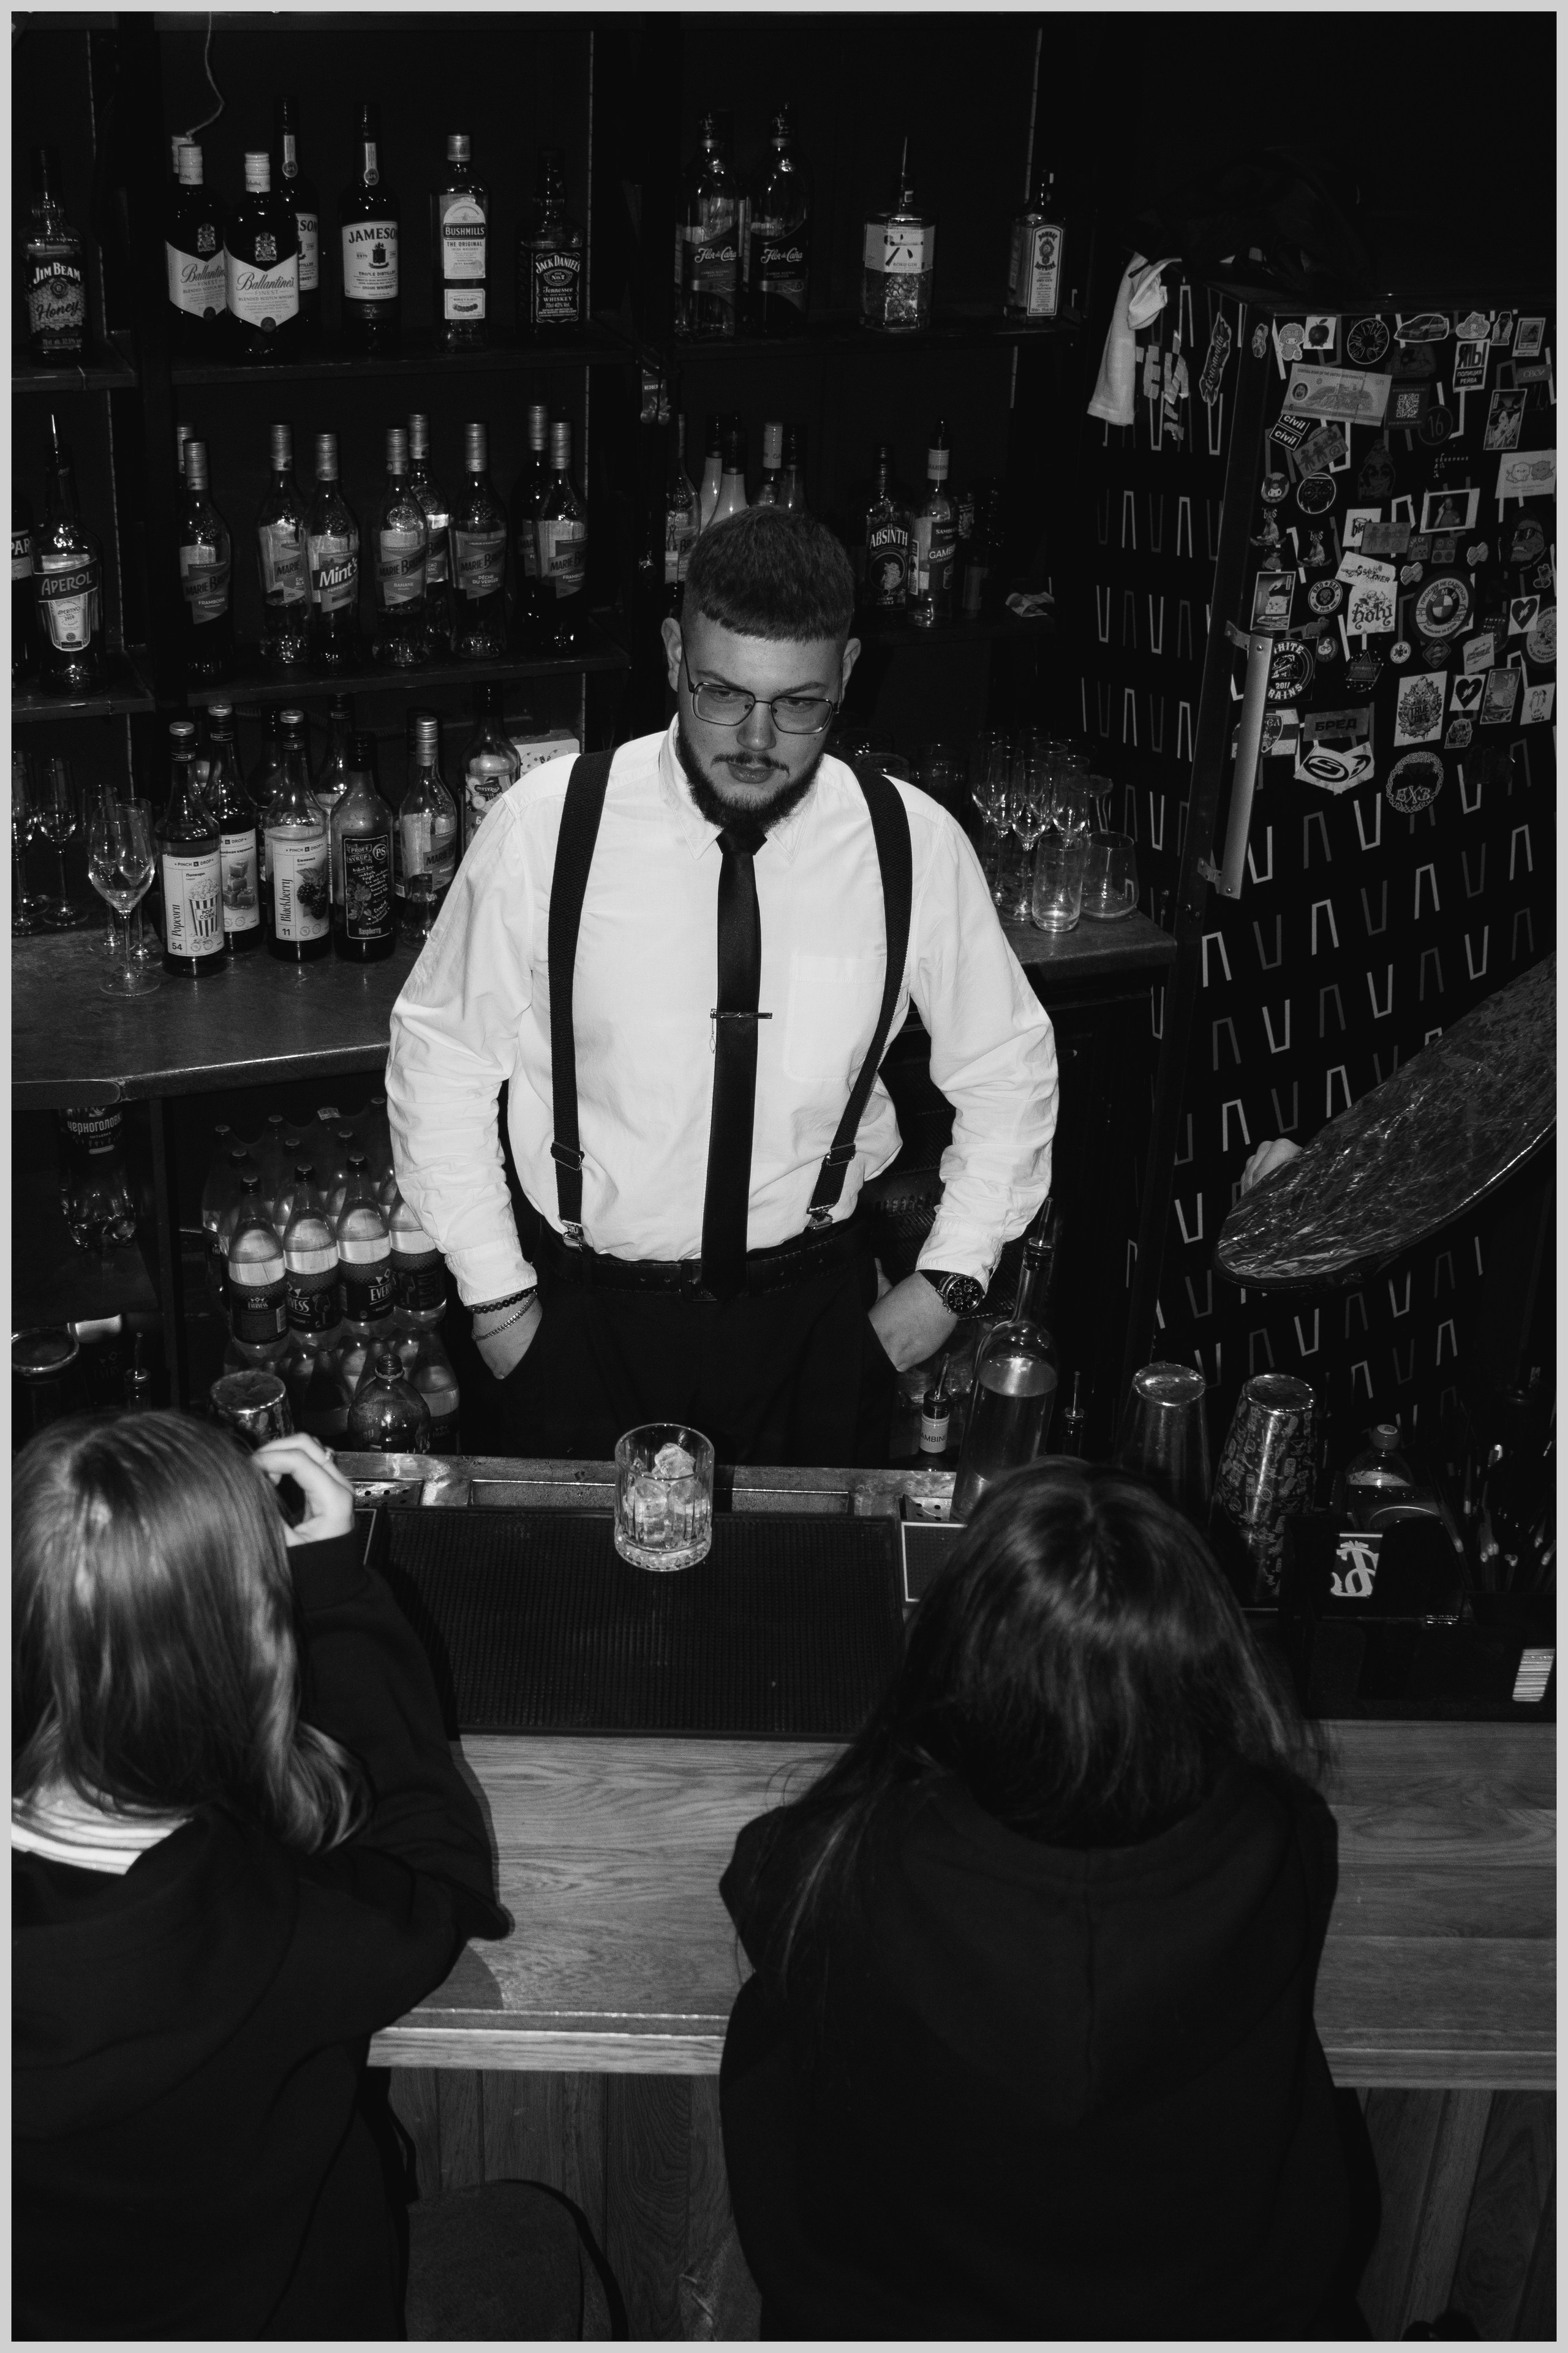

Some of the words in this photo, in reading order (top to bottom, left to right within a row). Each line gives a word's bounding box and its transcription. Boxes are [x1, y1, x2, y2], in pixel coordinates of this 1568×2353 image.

[445, 226, 485, 236] BUSHMILLS
[535, 258, 554, 274] JACK
[554, 255, 581, 273] DANIEL'S
[695, 247, 715, 263] Flor
[761, 248, 781, 264] Flor
[786, 247, 802, 263] Caña
[33, 266, 53, 285] JIM
[53, 262, 81, 282] BEAM
[181, 263, 226, 283] Ballantin
[236, 271, 295, 291] Ballantine's
[36, 301, 81, 320] Honey
[1283, 414, 1306, 430] civil
[1274, 429, 1297, 445] civil
[869, 529, 908, 550] ABSINTH
[320, 557, 358, 587] Mint's
[41, 571, 92, 596] APEROL
[1268, 683, 1303, 700] RAINS
[1315, 718, 1357, 732] БРЕД
[376, 847, 386, 858] PS
[279, 878, 293, 922] Blackberry
[172, 904, 185, 937] Popcorn
[370, 1283, 393, 1302] EVER
[921, 1432, 946, 1443] AMBINI
